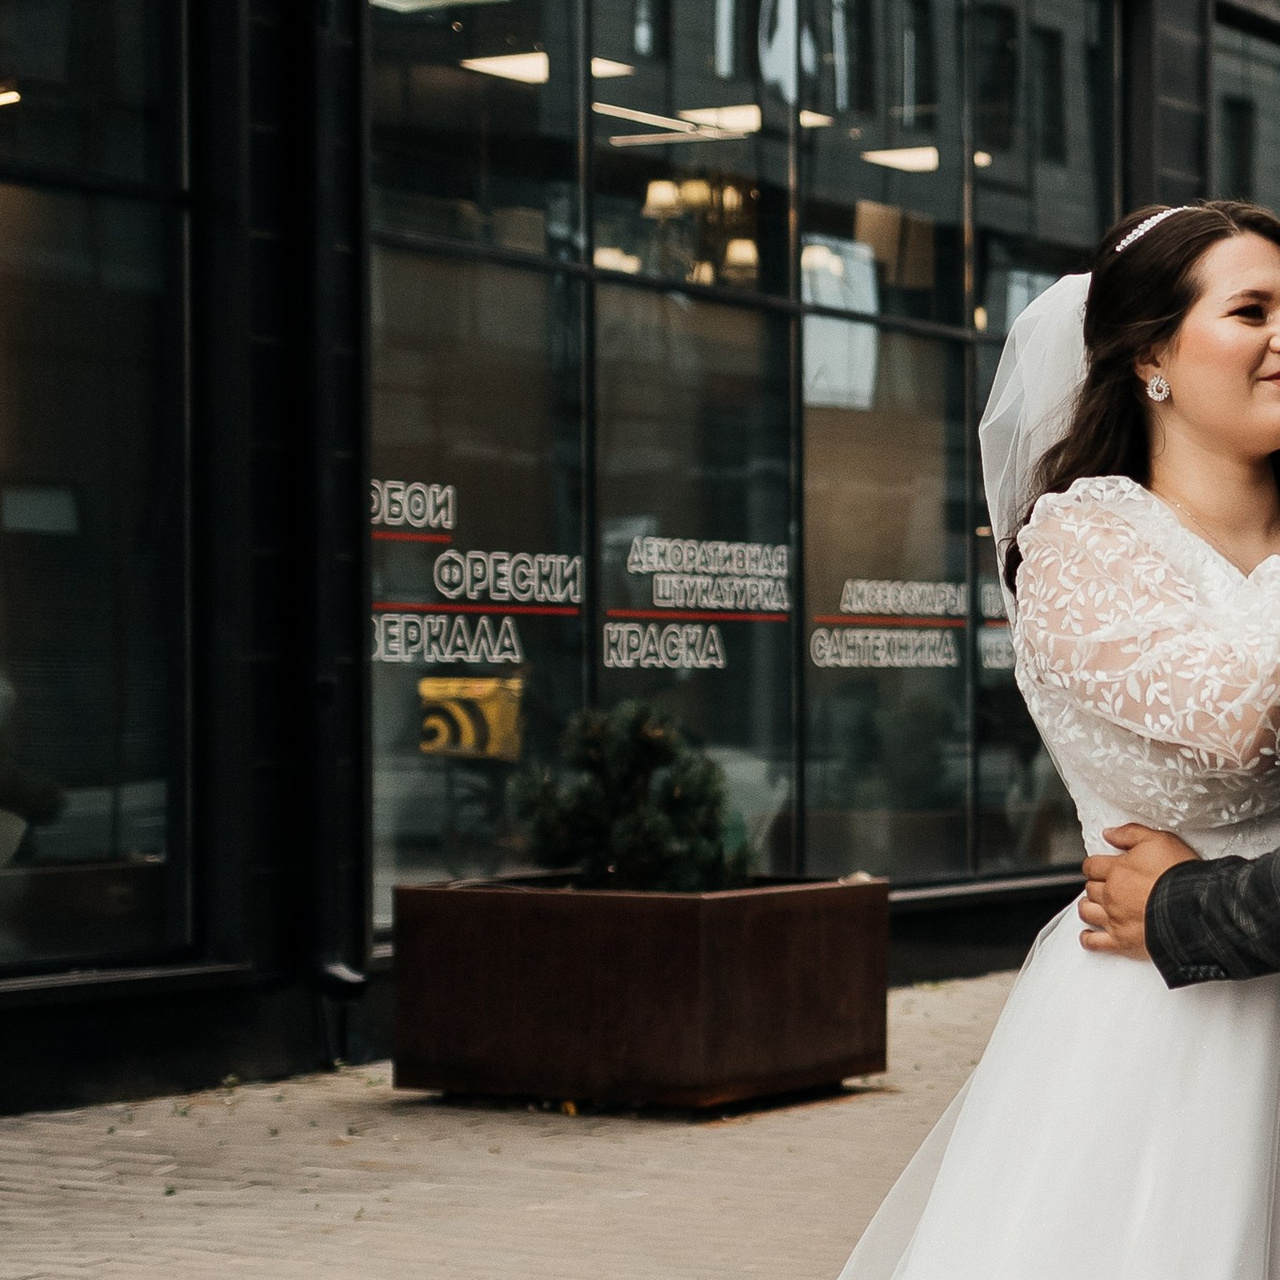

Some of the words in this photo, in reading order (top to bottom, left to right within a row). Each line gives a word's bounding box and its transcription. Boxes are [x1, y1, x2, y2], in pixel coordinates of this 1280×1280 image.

[433, 549, 584, 602] ФРЕСКИ
[626, 535, 789, 578] ДЕКОРАТИВНАЯ
[652, 573, 791, 611] ШТУКАТУРКА
[839, 578, 969, 615] АКСЕССУАРЫ
[603, 622, 727, 669] КРАСКА
[809, 627, 960, 668] САНТЕХНИКА
